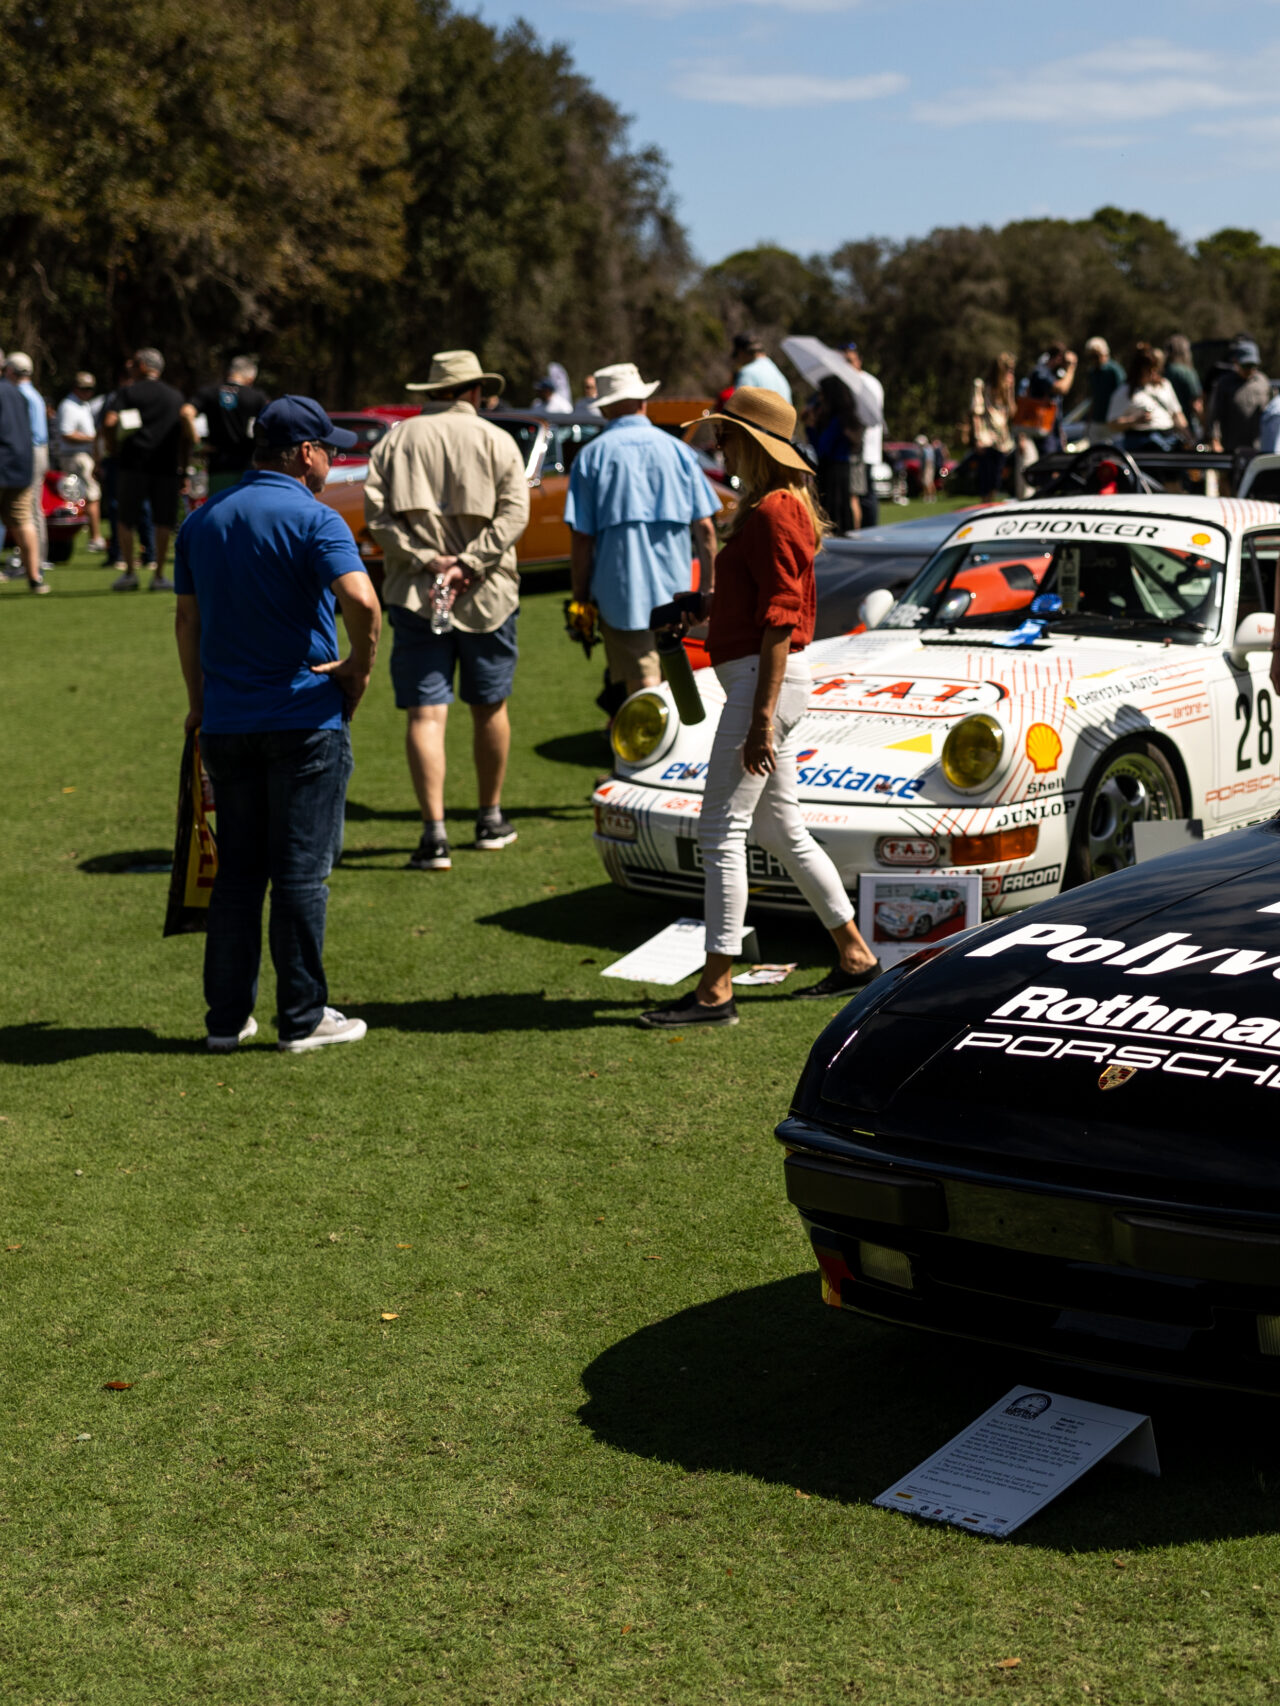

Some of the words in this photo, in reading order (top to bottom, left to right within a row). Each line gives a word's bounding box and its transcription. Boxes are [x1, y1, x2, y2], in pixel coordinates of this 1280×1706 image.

[1019, 520, 1159, 539] PIONEER
[1130, 675, 1160, 693] AUTO
[1235, 688, 1274, 773] 28
[797, 763, 926, 800] sistance
[1027, 777, 1065, 795] Shell
[996, 800, 1076, 828] DUNLOP
[1001, 867, 1060, 893] FACOM
